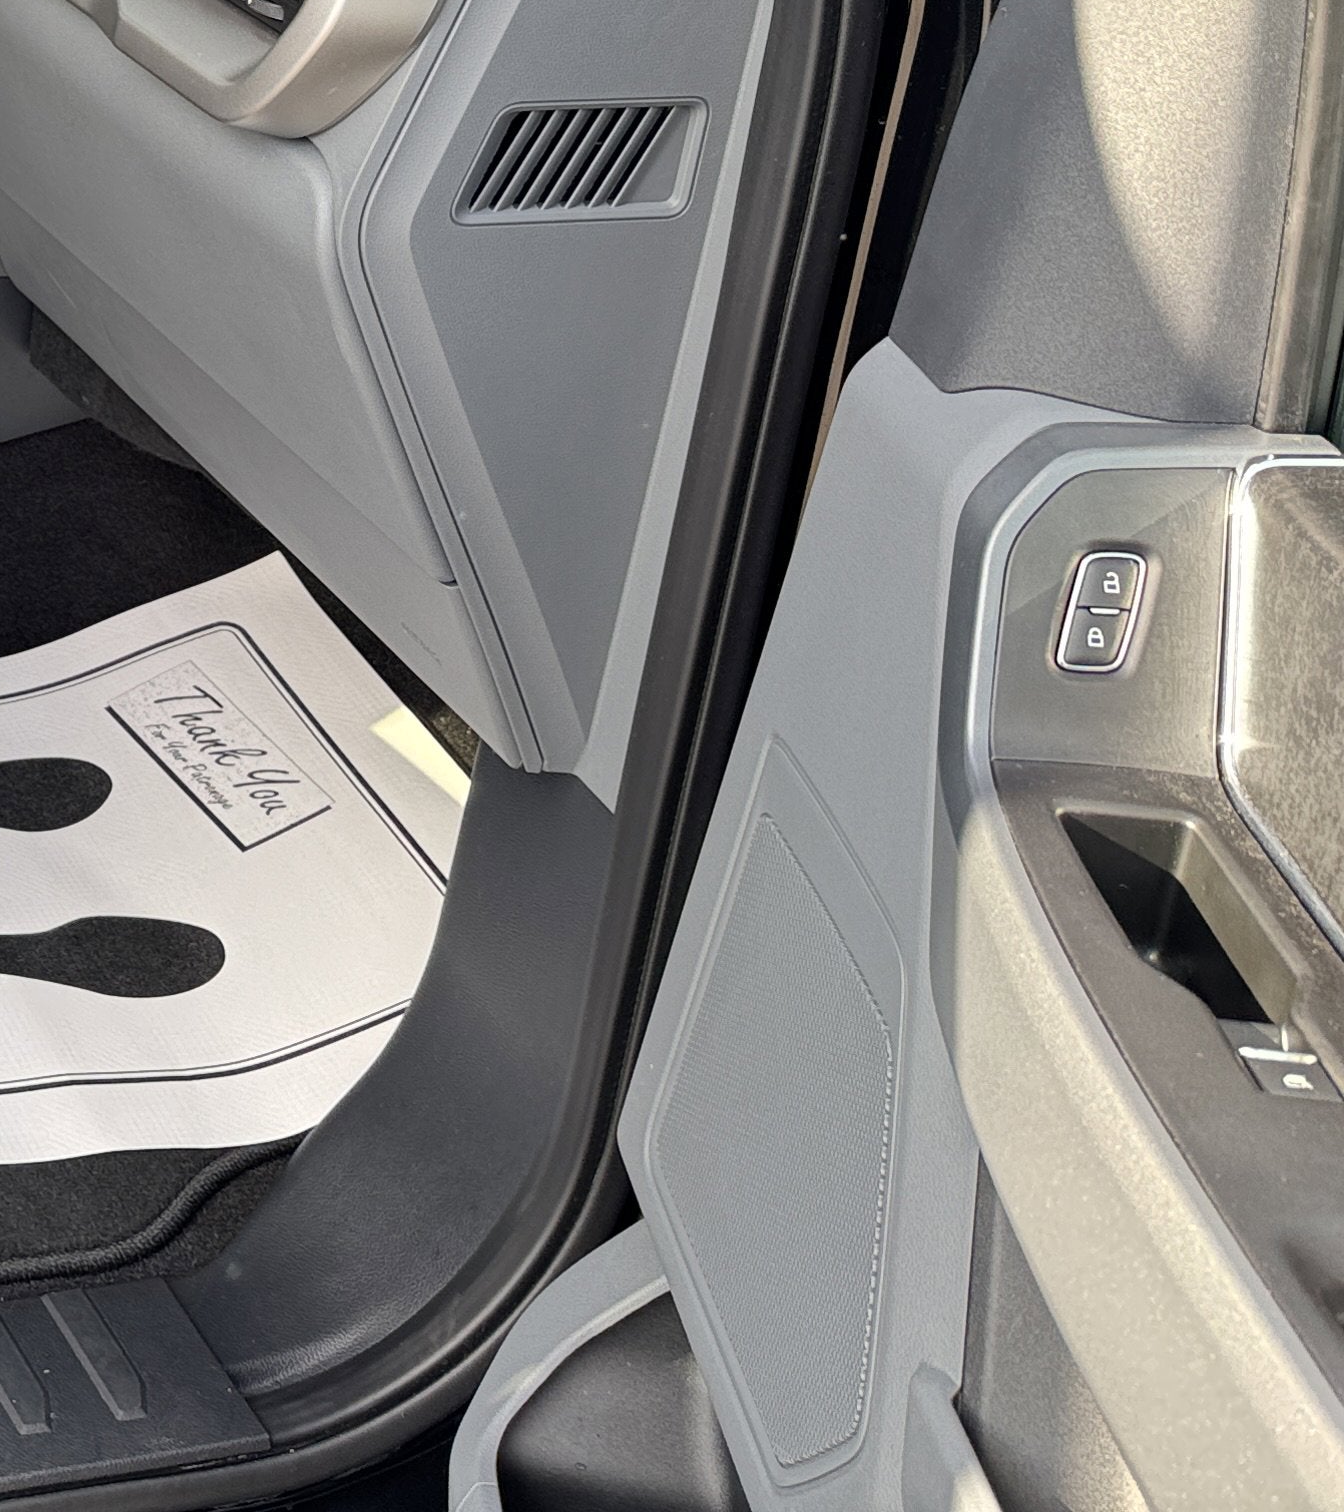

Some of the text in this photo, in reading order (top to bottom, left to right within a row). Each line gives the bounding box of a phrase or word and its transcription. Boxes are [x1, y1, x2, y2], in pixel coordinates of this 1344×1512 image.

[145, 722, 234, 810] For Your Patronage
[153, 685, 301, 816] Thank You
